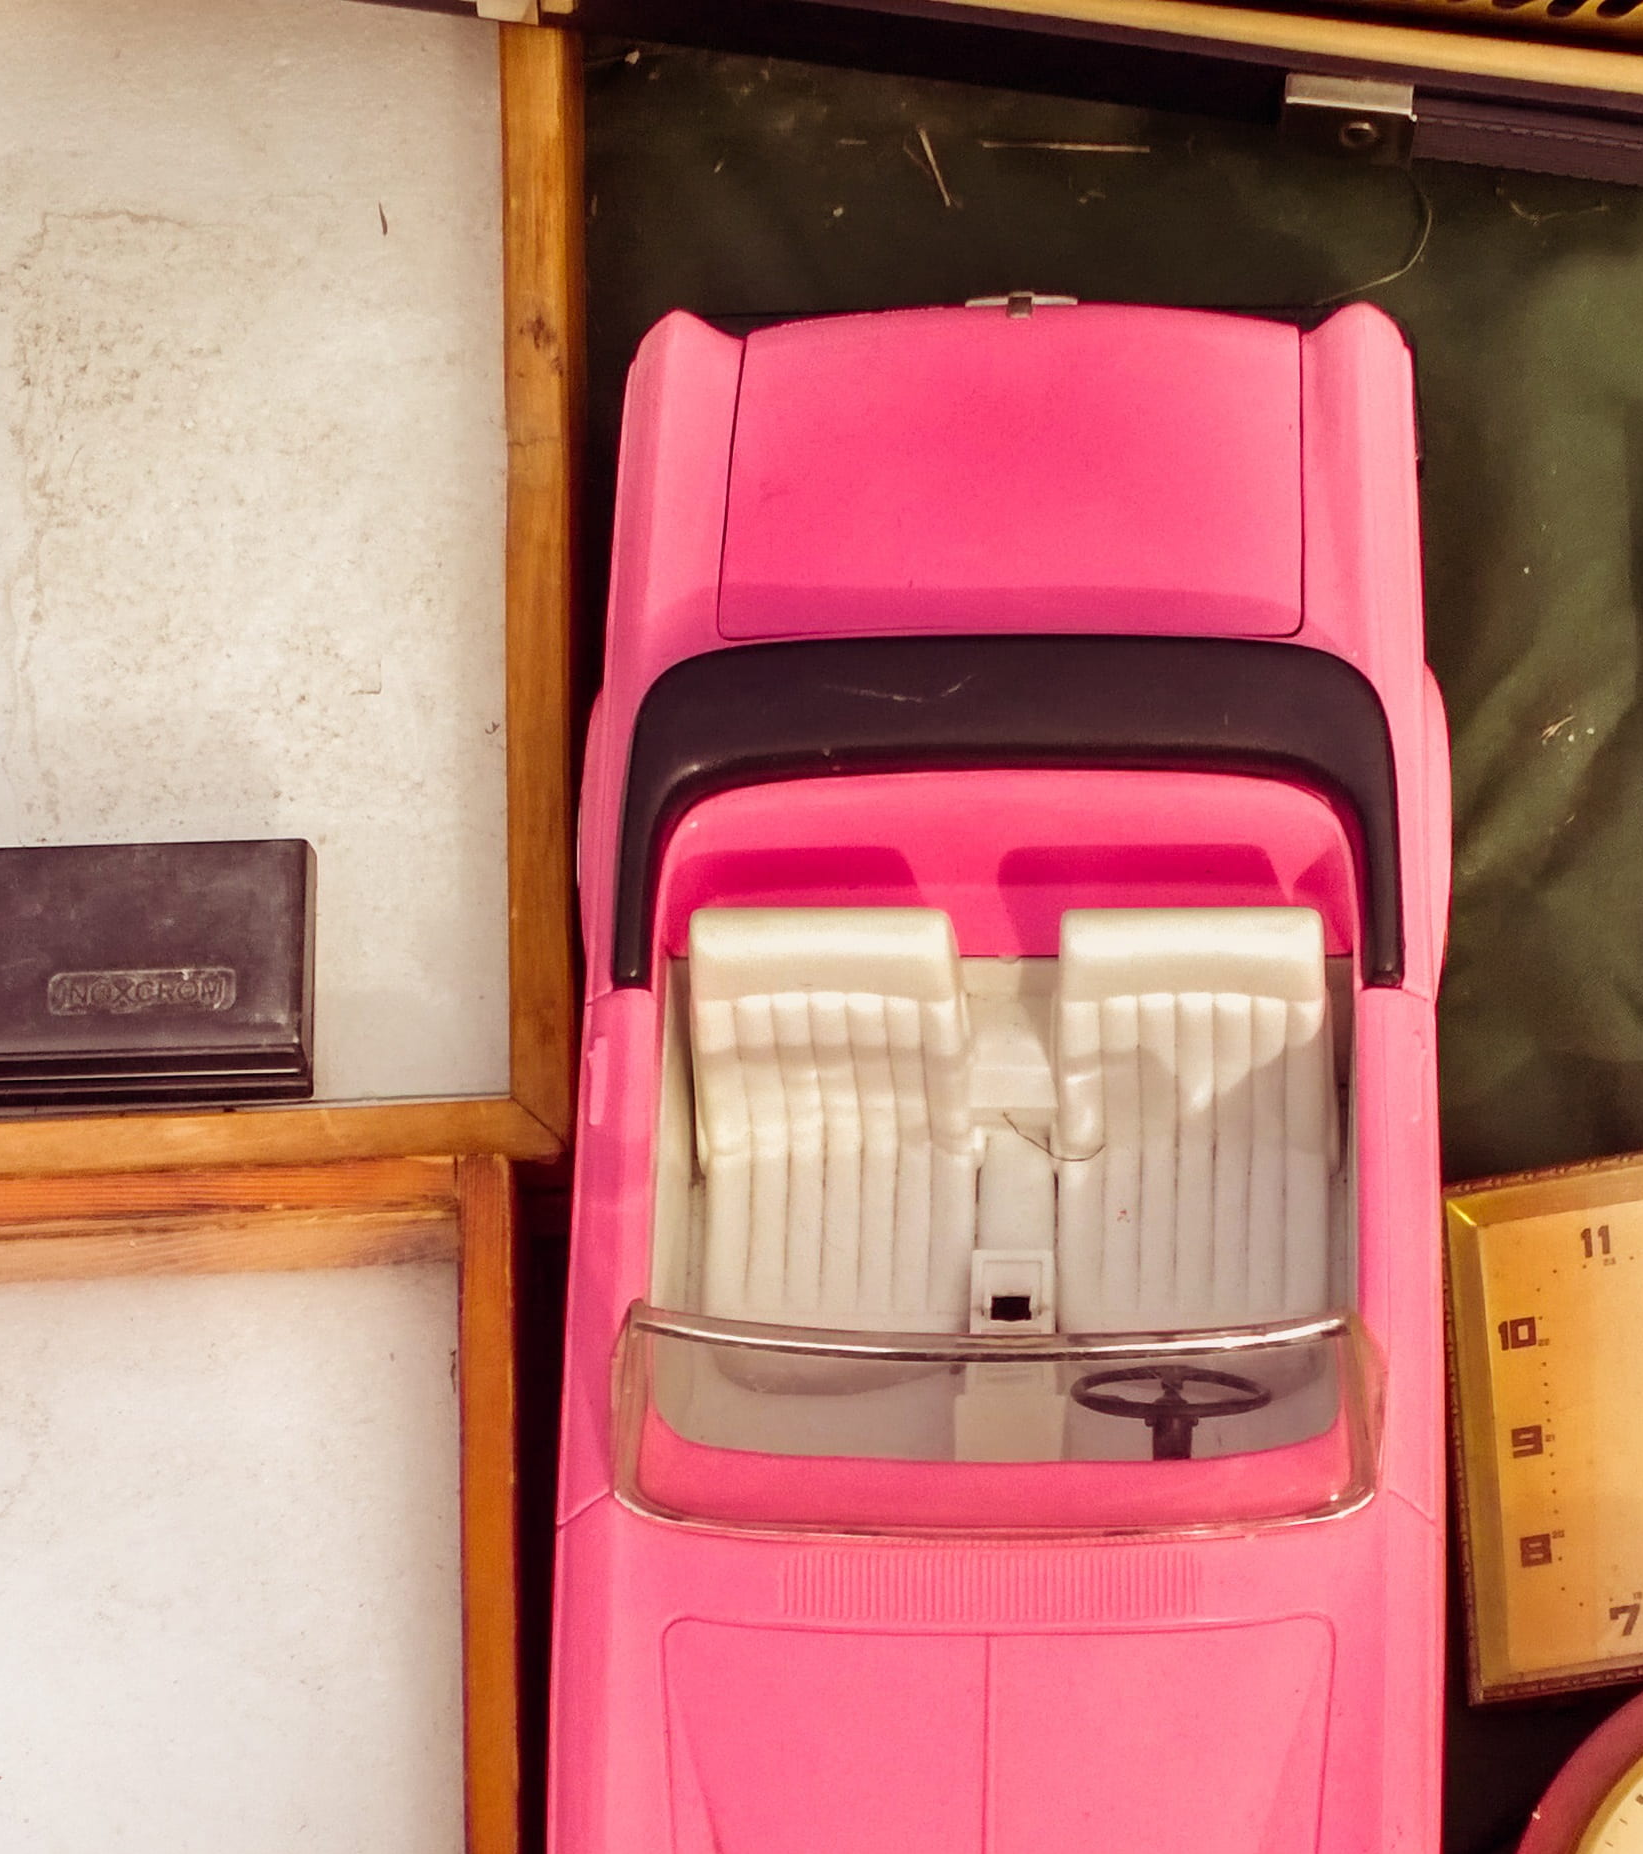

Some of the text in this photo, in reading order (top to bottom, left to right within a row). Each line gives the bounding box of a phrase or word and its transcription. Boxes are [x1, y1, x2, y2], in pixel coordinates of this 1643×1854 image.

[1580, 1225, 1611, 1259] 11
[1497, 1316, 1538, 1351] 10
[1510, 1424, 1544, 1459] 9
[1519, 1533, 1553, 1568] 8
[1609, 1603, 1642, 1636] 7
